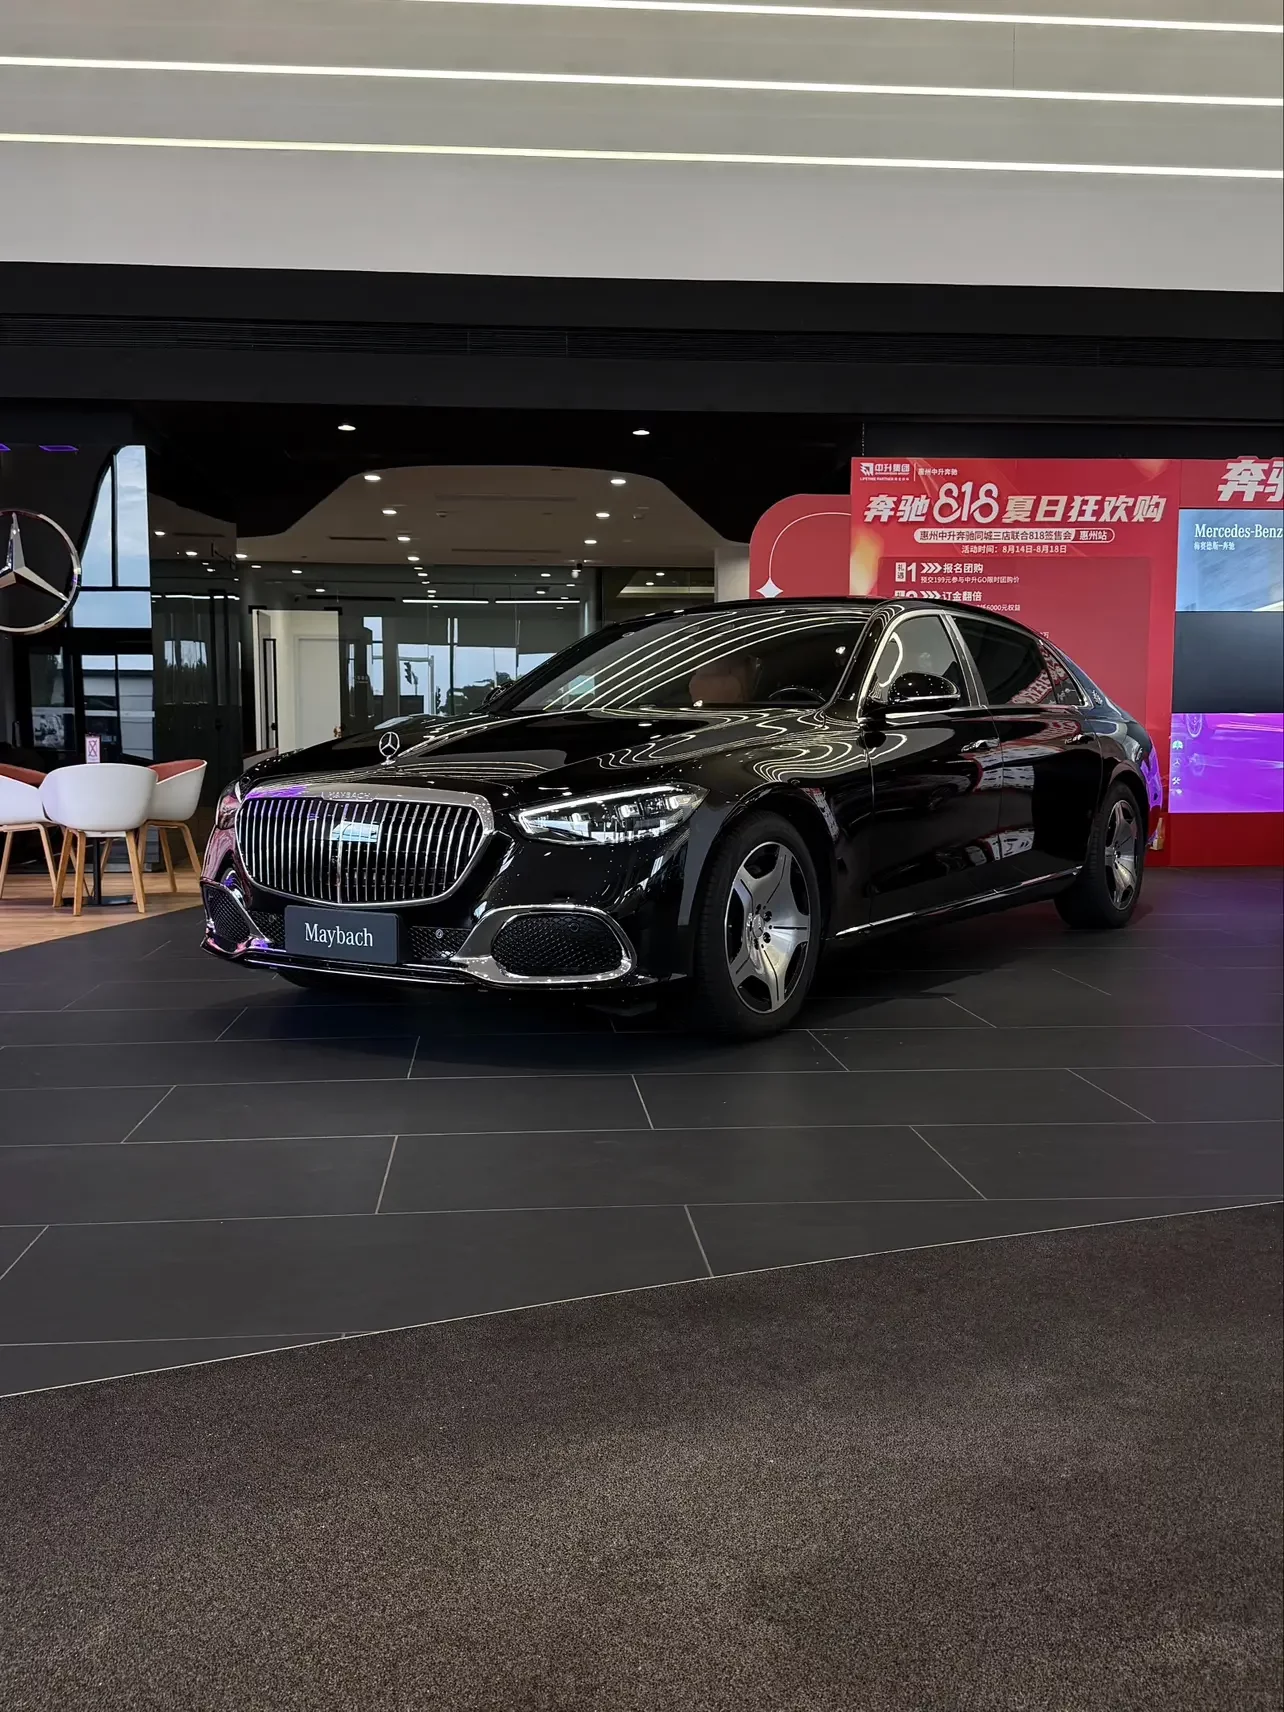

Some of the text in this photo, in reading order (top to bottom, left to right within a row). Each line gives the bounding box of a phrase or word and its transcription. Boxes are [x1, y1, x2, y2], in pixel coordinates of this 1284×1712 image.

[874, 463, 910, 473] 中升集团
[919, 530, 1073, 541] 惠州中升奔驰同城三店联合818签售会
[1079, 530, 1107, 541] 惠州站
[1194, 523, 1283, 538] Mercedes-Benz
[943, 563, 984, 574] 报名团购
[304, 923, 374, 948] Maybach
